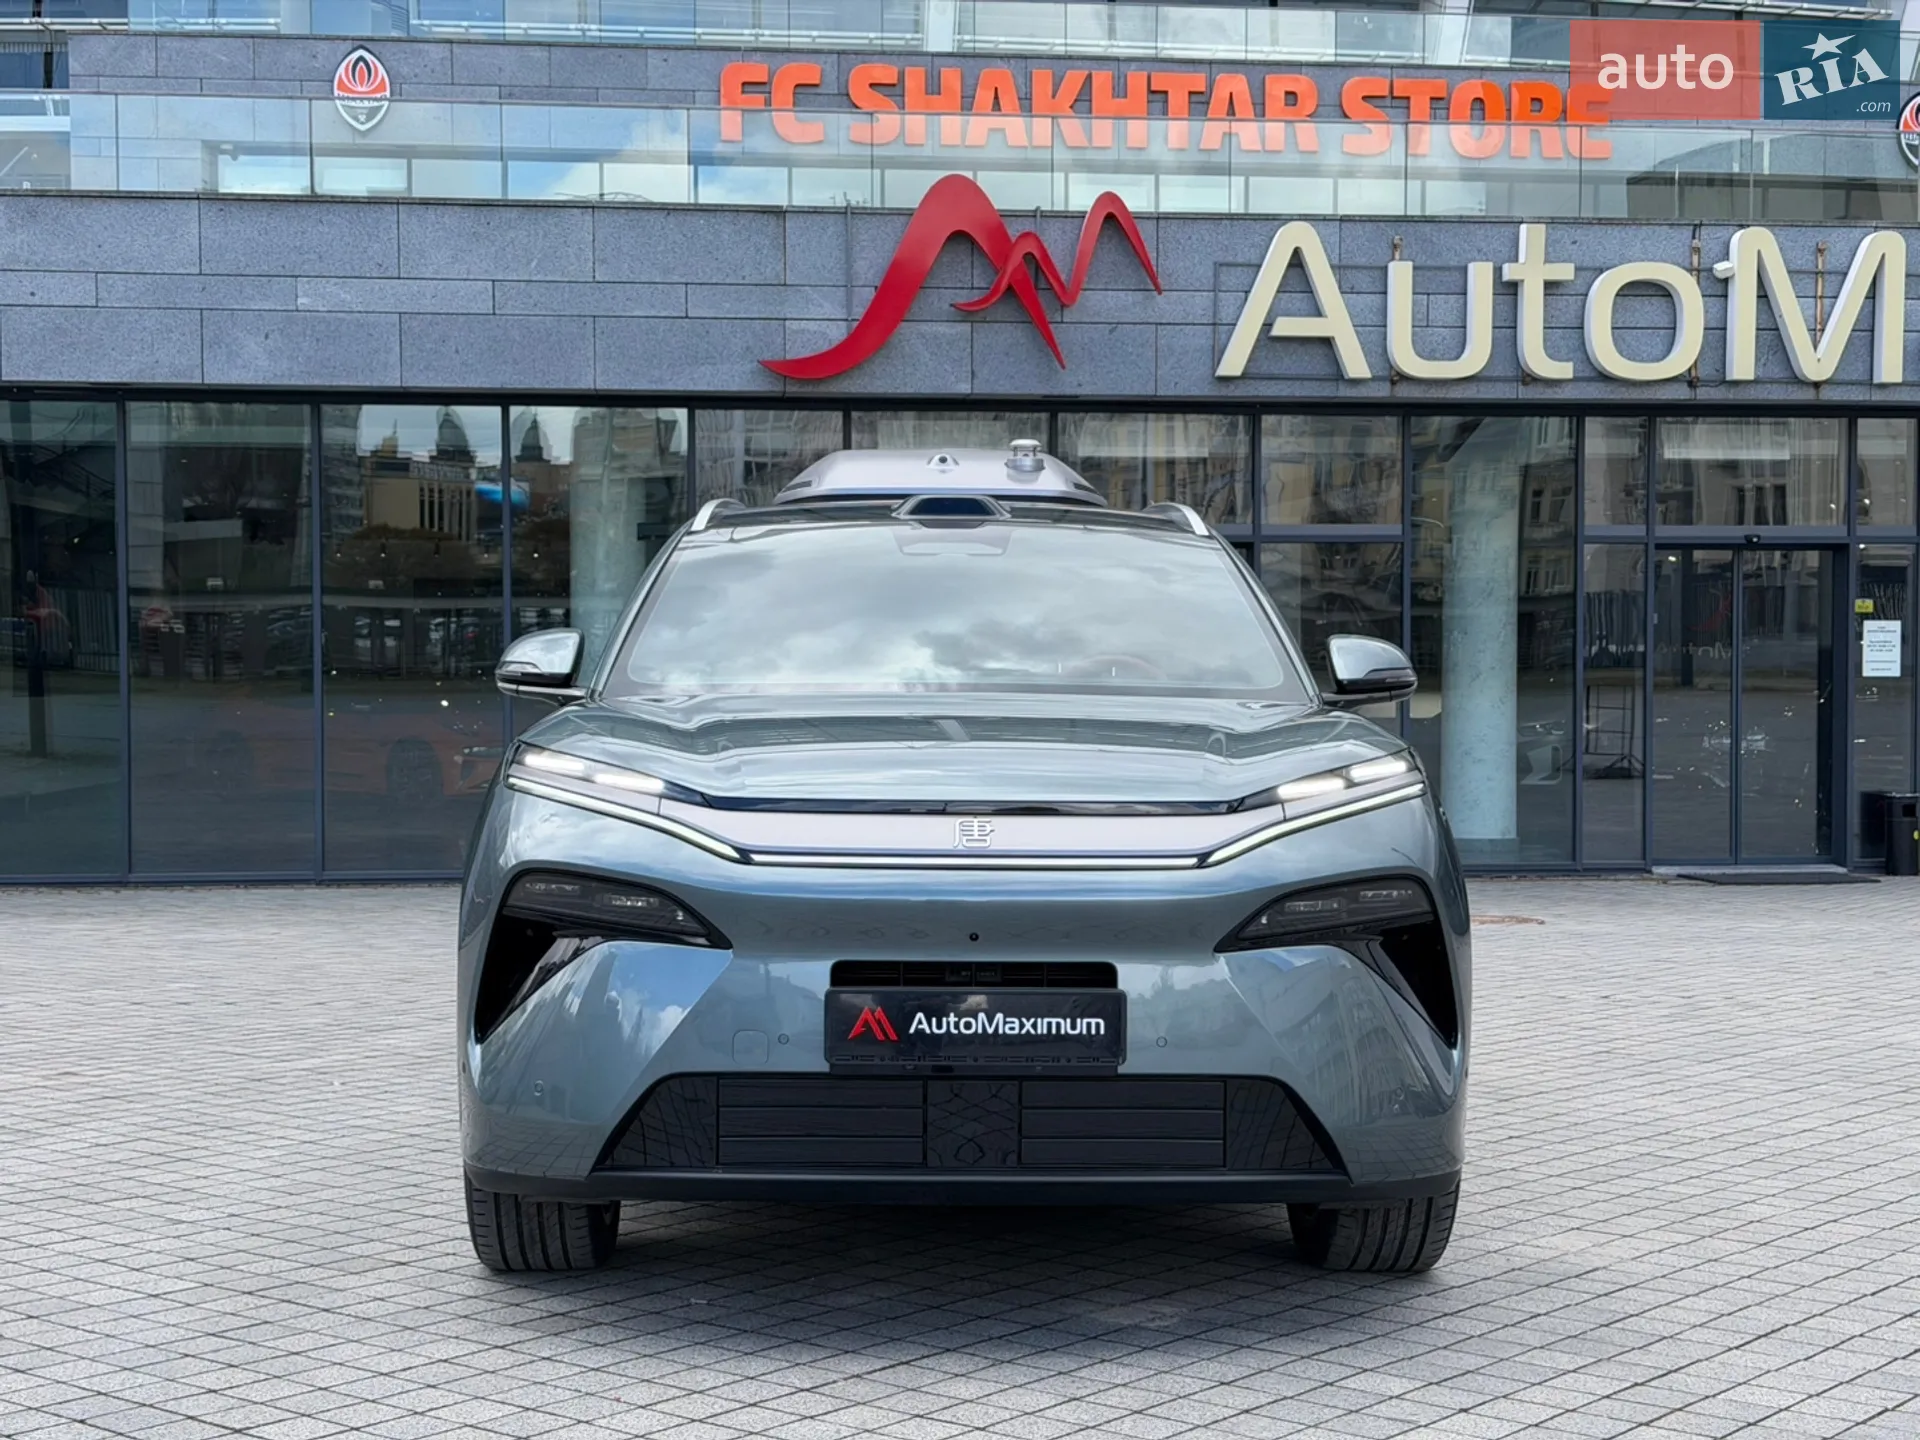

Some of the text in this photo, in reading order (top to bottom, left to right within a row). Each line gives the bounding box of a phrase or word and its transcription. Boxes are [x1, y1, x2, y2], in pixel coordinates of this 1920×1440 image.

[719, 62, 1614, 160] FC SHAKHTAR STORE
[1213, 220, 1907, 385] AutoM
[908, 1011, 1106, 1036] AutoMaximum
